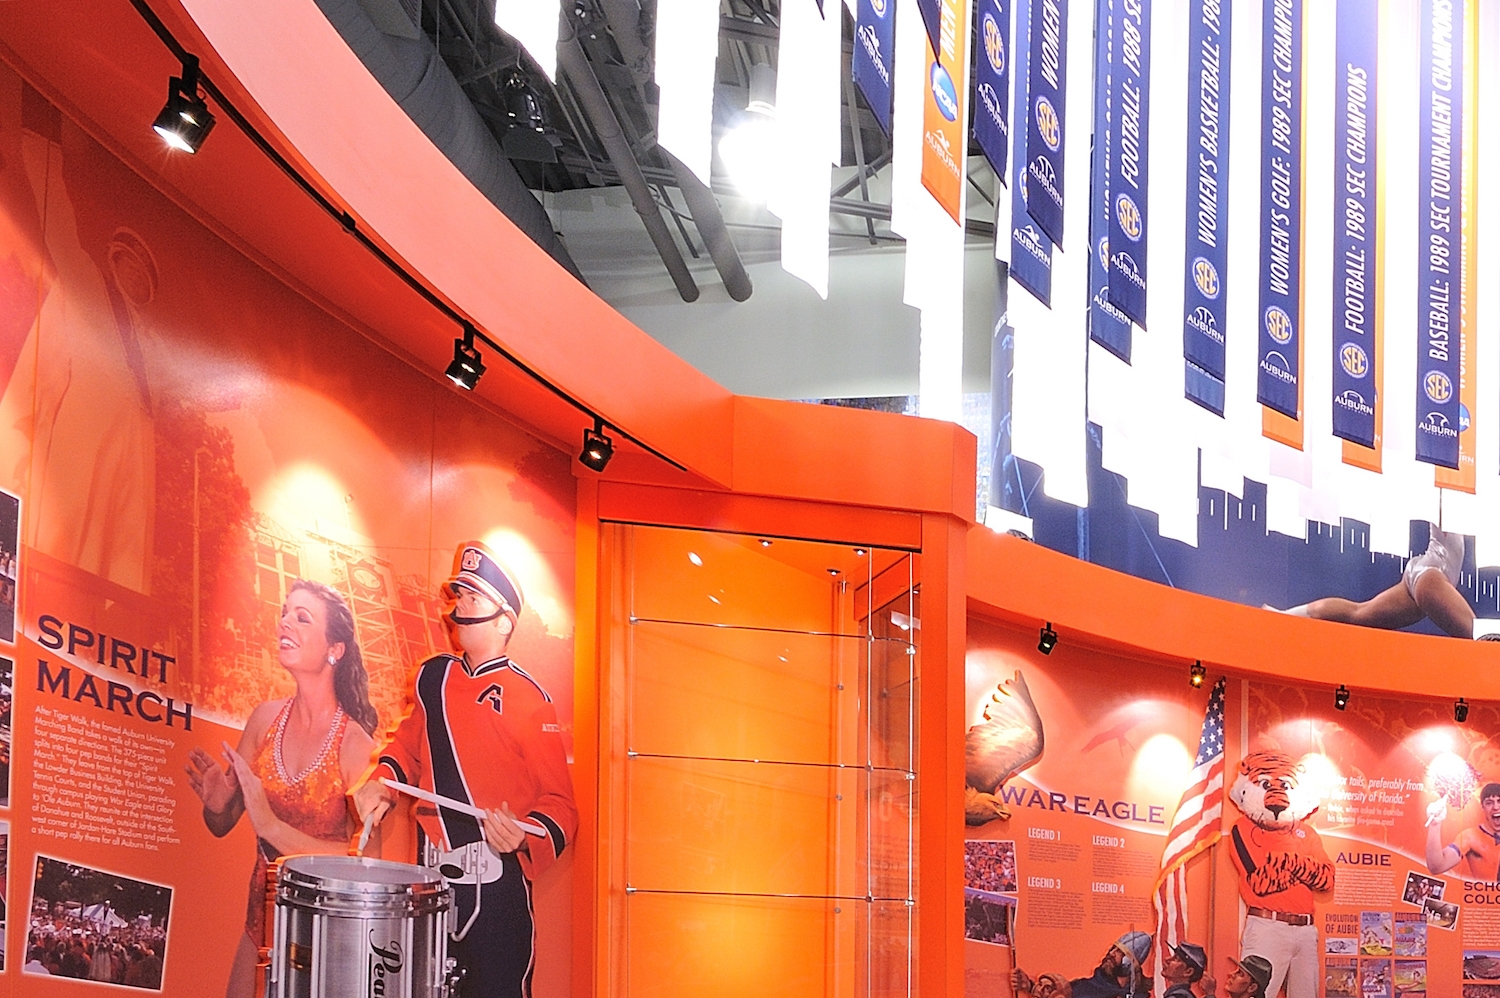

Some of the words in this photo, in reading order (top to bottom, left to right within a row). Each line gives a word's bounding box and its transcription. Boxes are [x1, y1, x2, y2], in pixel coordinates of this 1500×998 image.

[1122, 22, 1141, 77] 1988
[1272, 71, 1292, 108] SEC
[1272, 106, 1291, 154] 1989
[1346, 63, 1367, 164] CHAMPIONS
[1431, 91, 1451, 202] TOURNAMENT
[1346, 164, 1366, 198] SEC
[1198, 154, 1217, 247] WOMEN'S
[1430, 202, 1450, 232] SEC
[1346, 198, 1365, 241] 1989
[1013, 228, 1051, 266] AUBURN
[1270, 209, 1290, 295] WOMEN'S
[1430, 234, 1450, 275] 1989
[1345, 245, 1365, 334] FOOTBALL:
[1429, 279, 1449, 361] BASEBALL:
[1260, 359, 1297, 384] AUBURN
[38, 614, 176, 684] SPIRIT
[36, 659, 193, 731] MARCH
[35, 716, 66, 733] Marching
[53, 709, 69, 722] Tiger
[122, 728, 145, 739] Auburn
[146, 734, 175, 749] University
[1368, 777, 1405, 791] preferably
[1406, 780, 1424, 790] from
[1369, 793, 1377, 802] of
[110, 796, 124, 805] War
[125, 799, 142, 810] Eagle
[999, 784, 1067, 813] WAR
[1073, 795, 1165, 824] EAGLE
[118, 828, 142, 838] Stadium
[121, 839, 144, 849] Auburn
[1028, 827, 1055, 841] LEGEND
[1056, 831, 1061, 841] 1
[1092, 835, 1118, 848] LEGEND
[1119, 837, 1125, 848] 2
[1336, 852, 1391, 866] AUBIE
[1028, 876, 1054, 888] LEGEND
[1056, 879, 1061, 889] 3
[1092, 882, 1117, 893] LEGEND
[1118, 884, 1125, 894] 4
[1325, 913, 1358, 922] EVOLUTION
[1325, 923, 1335, 933] OF
[1337, 925, 1358, 934] AUBIE
